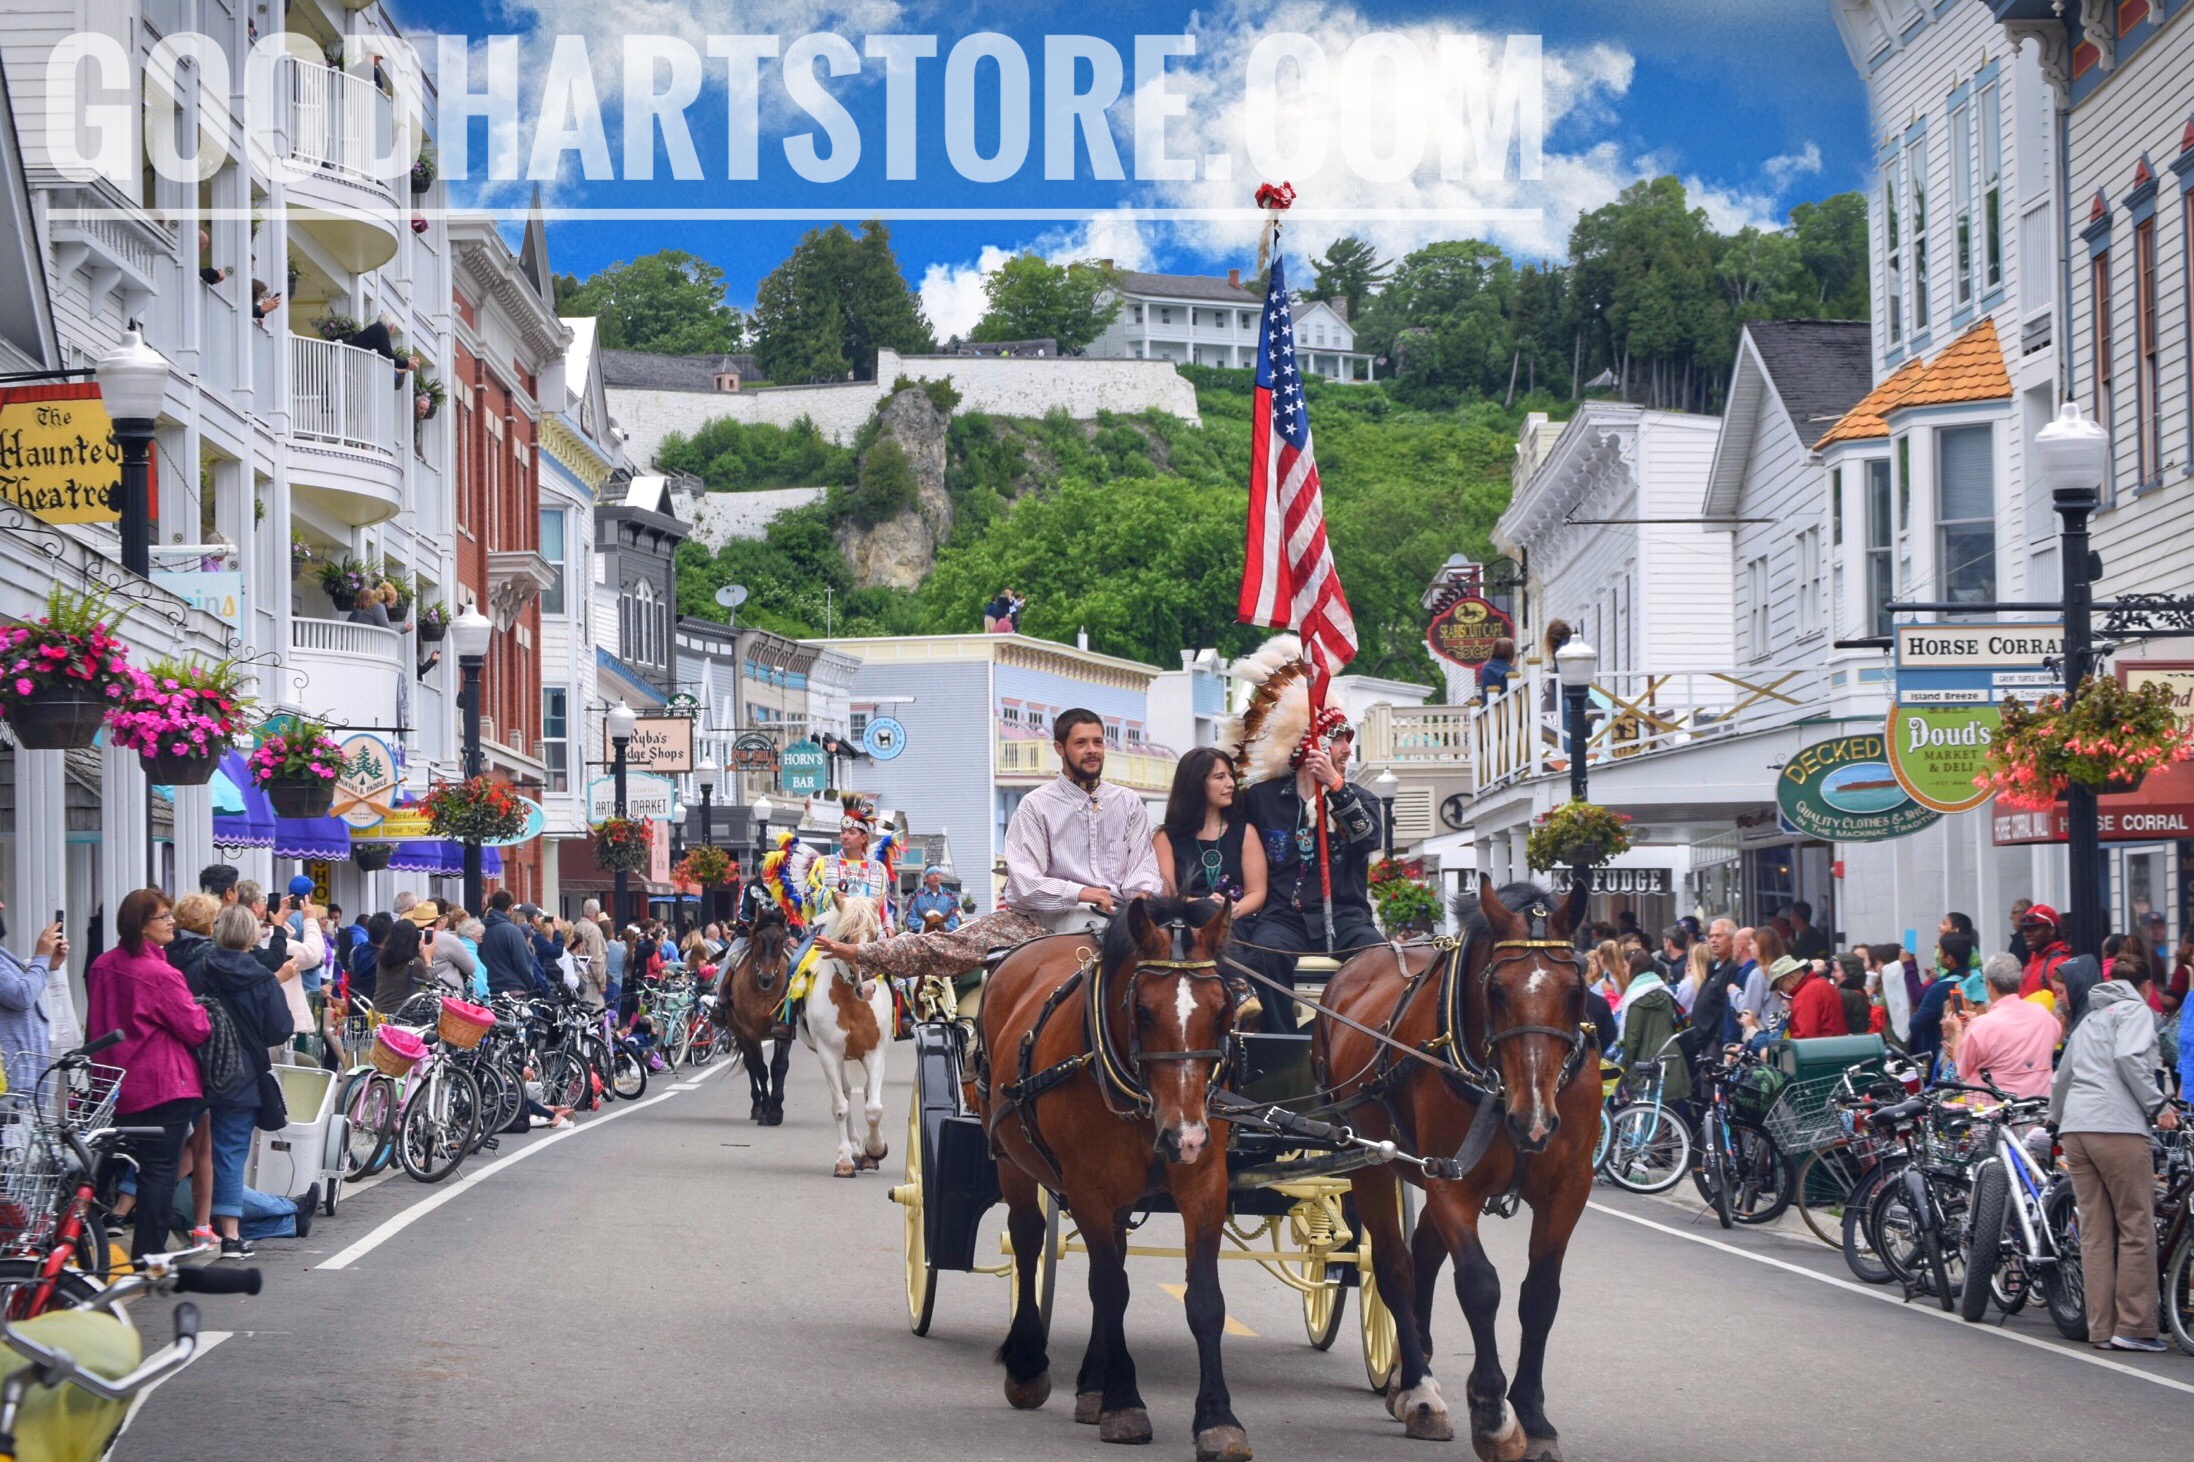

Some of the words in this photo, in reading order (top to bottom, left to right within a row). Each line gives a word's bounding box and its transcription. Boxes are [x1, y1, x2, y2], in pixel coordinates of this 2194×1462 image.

[36, 406, 72, 427] The
[0, 428, 124, 471] Haunted
[1908, 637, 1978, 656] HORSE
[1911, 691, 1940, 700] Island
[1945, 691, 1979, 700] Breeze
[629, 728, 668, 748] Ryba's
[1906, 716, 1992, 754] Doud's
[649, 747, 684, 763] Shops
[784, 753, 824, 766] HORN'S
[1784, 737, 1882, 785] DECKED
[1924, 750, 1978, 760] MARKET
[1929, 763, 1939, 773] &
[1943, 762, 1974, 772] DELI
[339, 778, 358, 793] ANVAS
[366, 778, 388, 794] PADDLE
[792, 776, 815, 788] BAR
[630, 799, 667, 816] MARKET
[1796, 800, 1841, 829] QUALITY
[1842, 816, 1889, 830] CLOTHES
[1892, 813, 1905, 826] &
[1904, 805, 1928, 821] SHO
[1796, 816, 1807, 827] IN
[1811, 824, 1831, 836] THE
[1836, 828, 1889, 838] MACKINAC
[1894, 811, 1938, 833] TRADITIO
[2059, 814, 2115, 833] HSE
[2121, 814, 2189, 831] CORRAL
[1592, 869, 1662, 892] FUDGE
